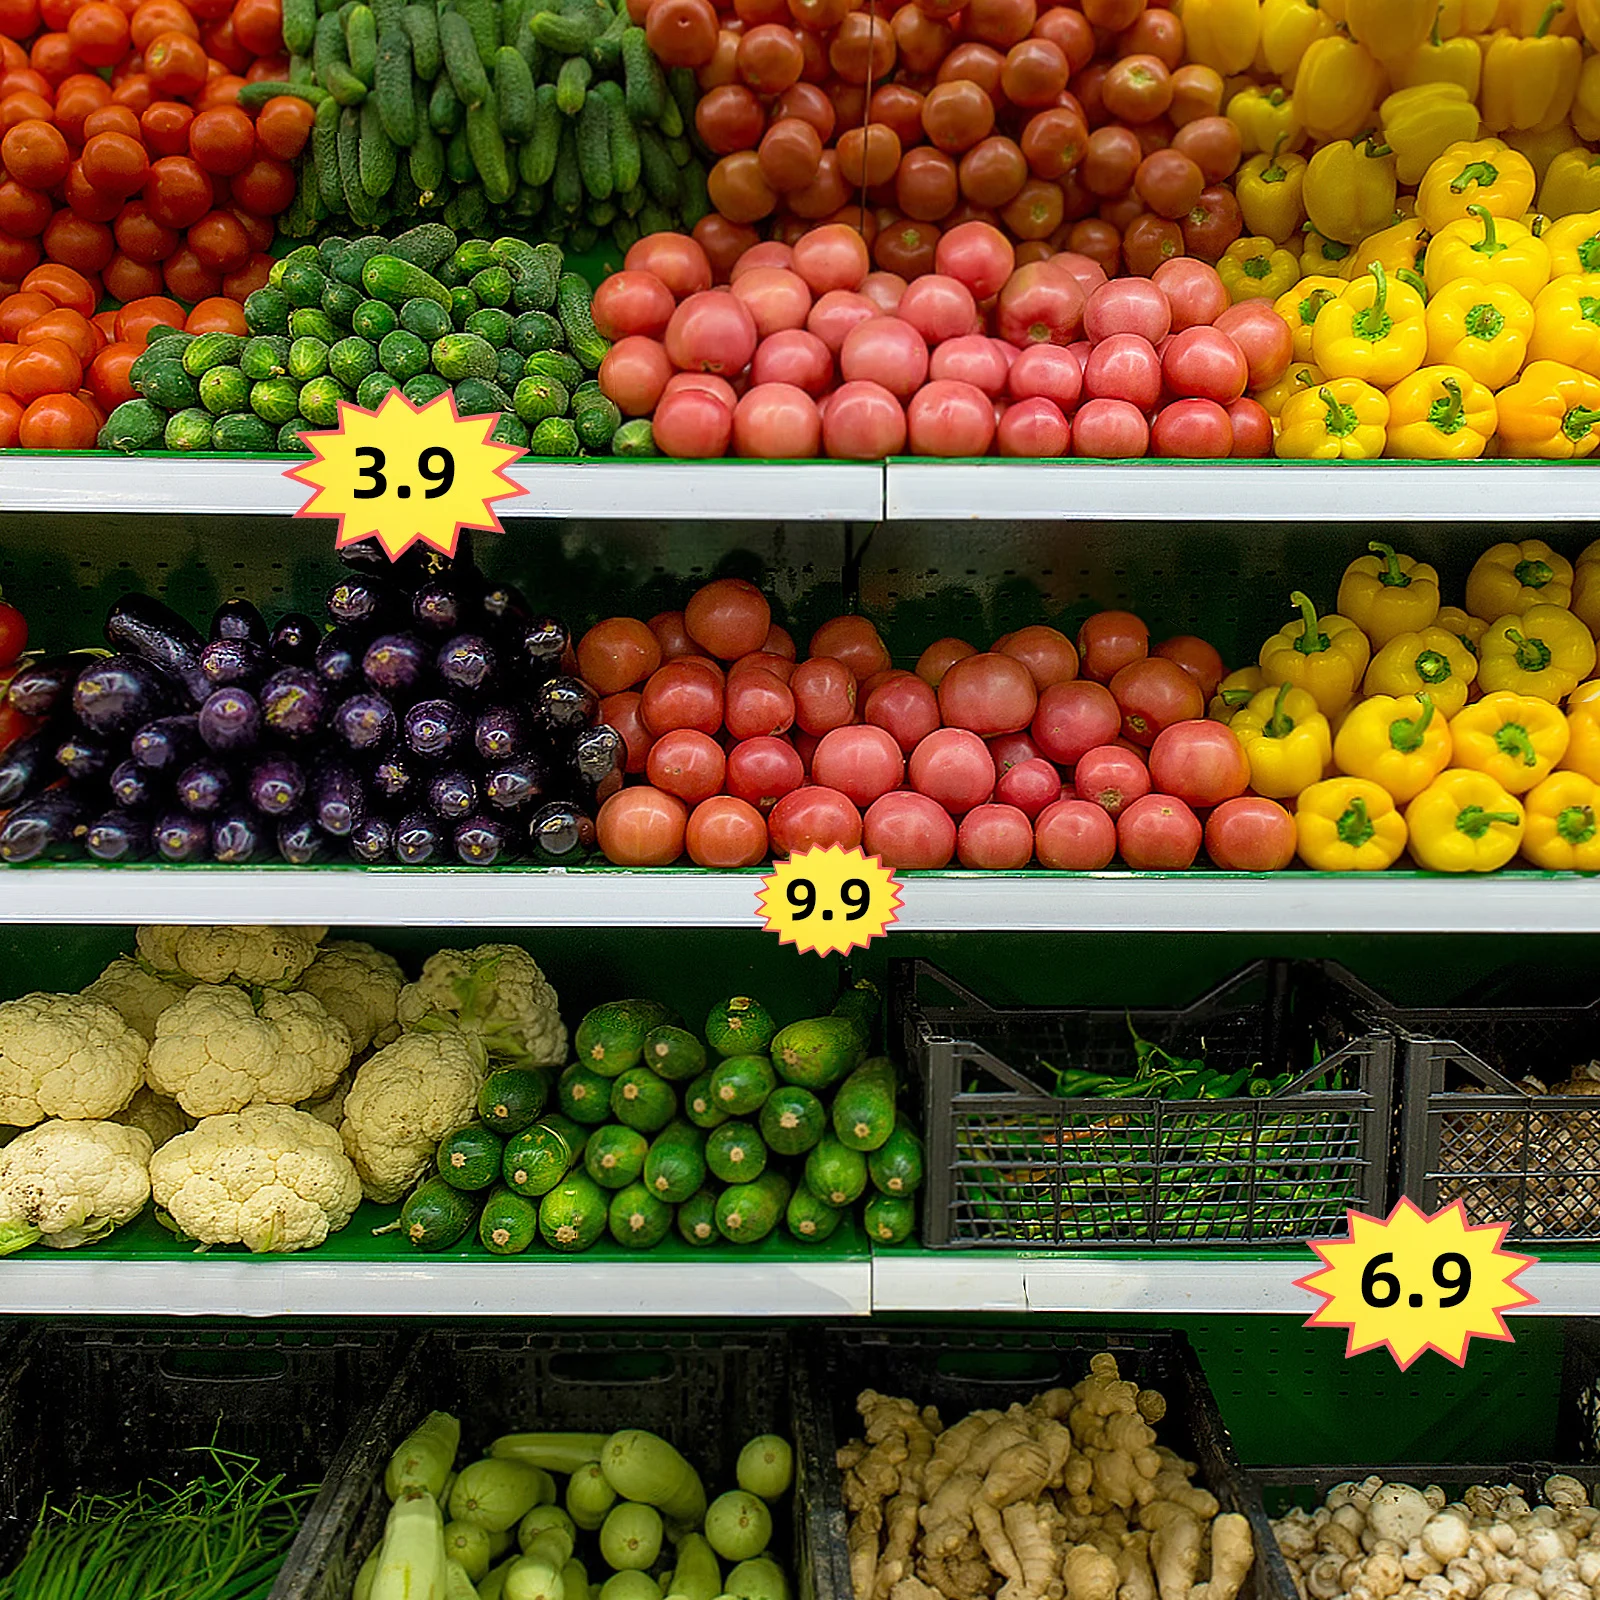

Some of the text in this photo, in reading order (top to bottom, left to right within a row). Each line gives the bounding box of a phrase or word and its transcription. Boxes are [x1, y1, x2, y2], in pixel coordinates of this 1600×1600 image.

[353, 446, 455, 499] 3.9
[786, 878, 870, 921] 9.9
[1361, 1252, 1472, 1308] 6.9
